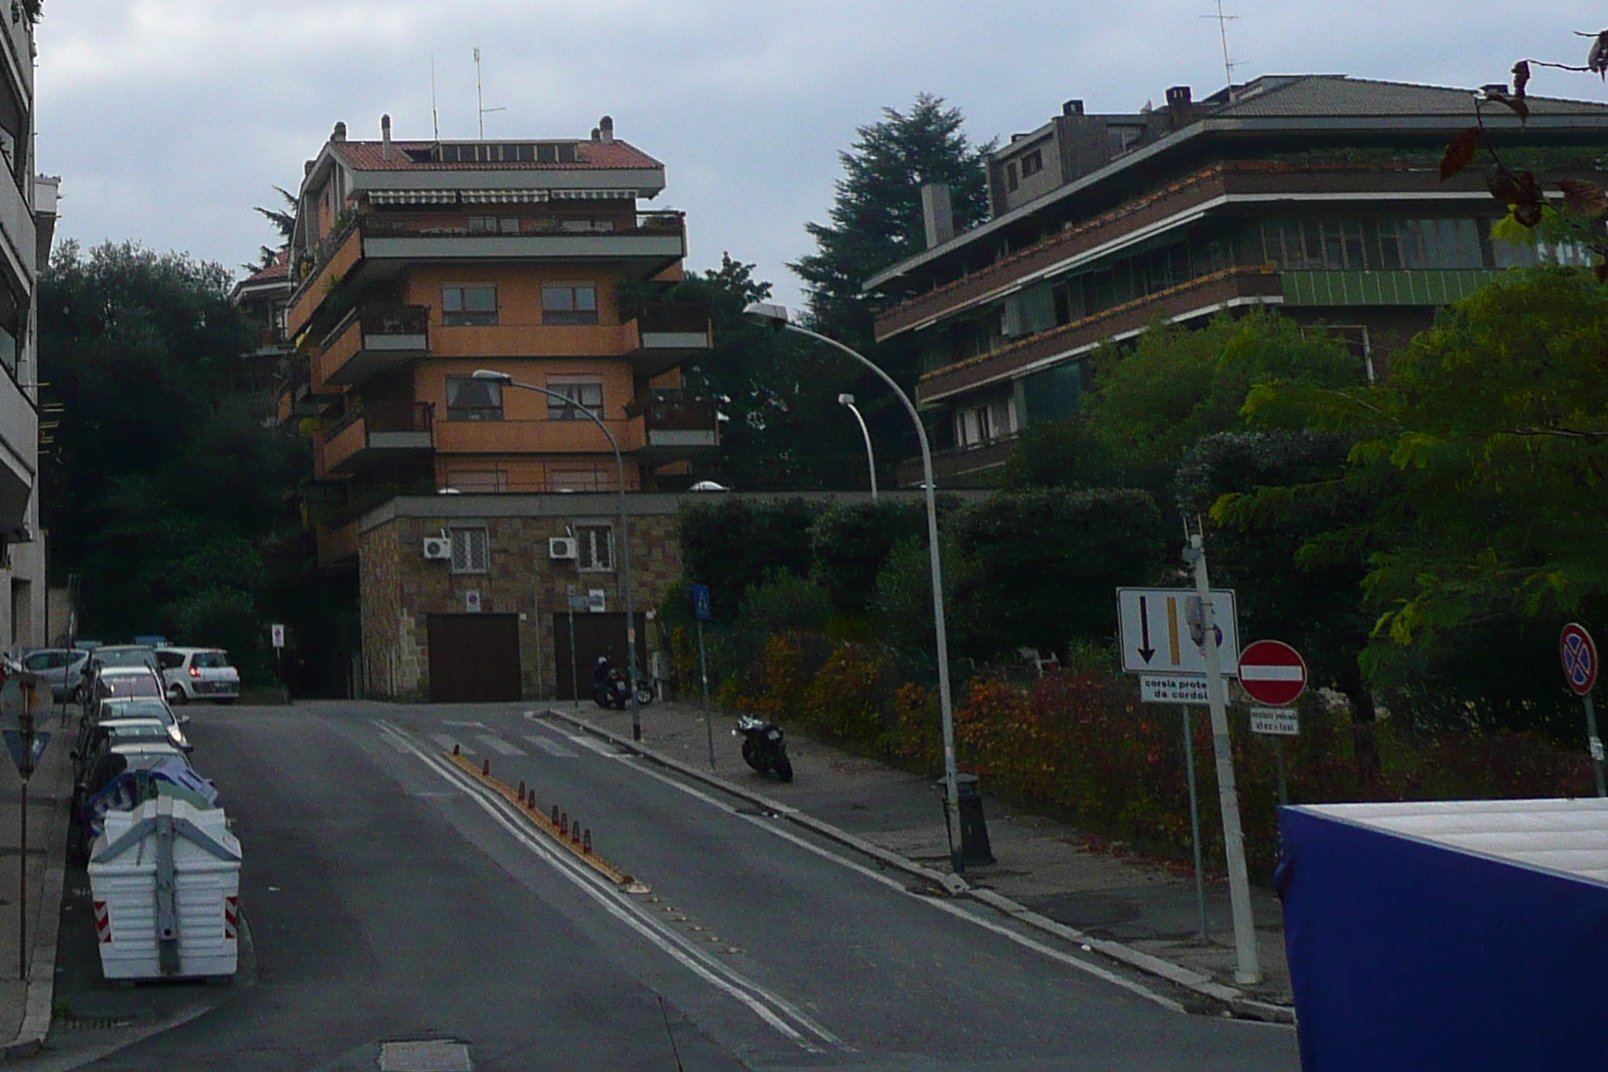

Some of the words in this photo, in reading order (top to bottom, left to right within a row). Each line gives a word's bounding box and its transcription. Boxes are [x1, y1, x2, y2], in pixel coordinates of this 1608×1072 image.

[1145, 679, 1177, 689] corsia
[1178, 680, 1208, 691] prote
[1154, 689, 1168, 699] da
[1172, 689, 1208, 700] cordol
